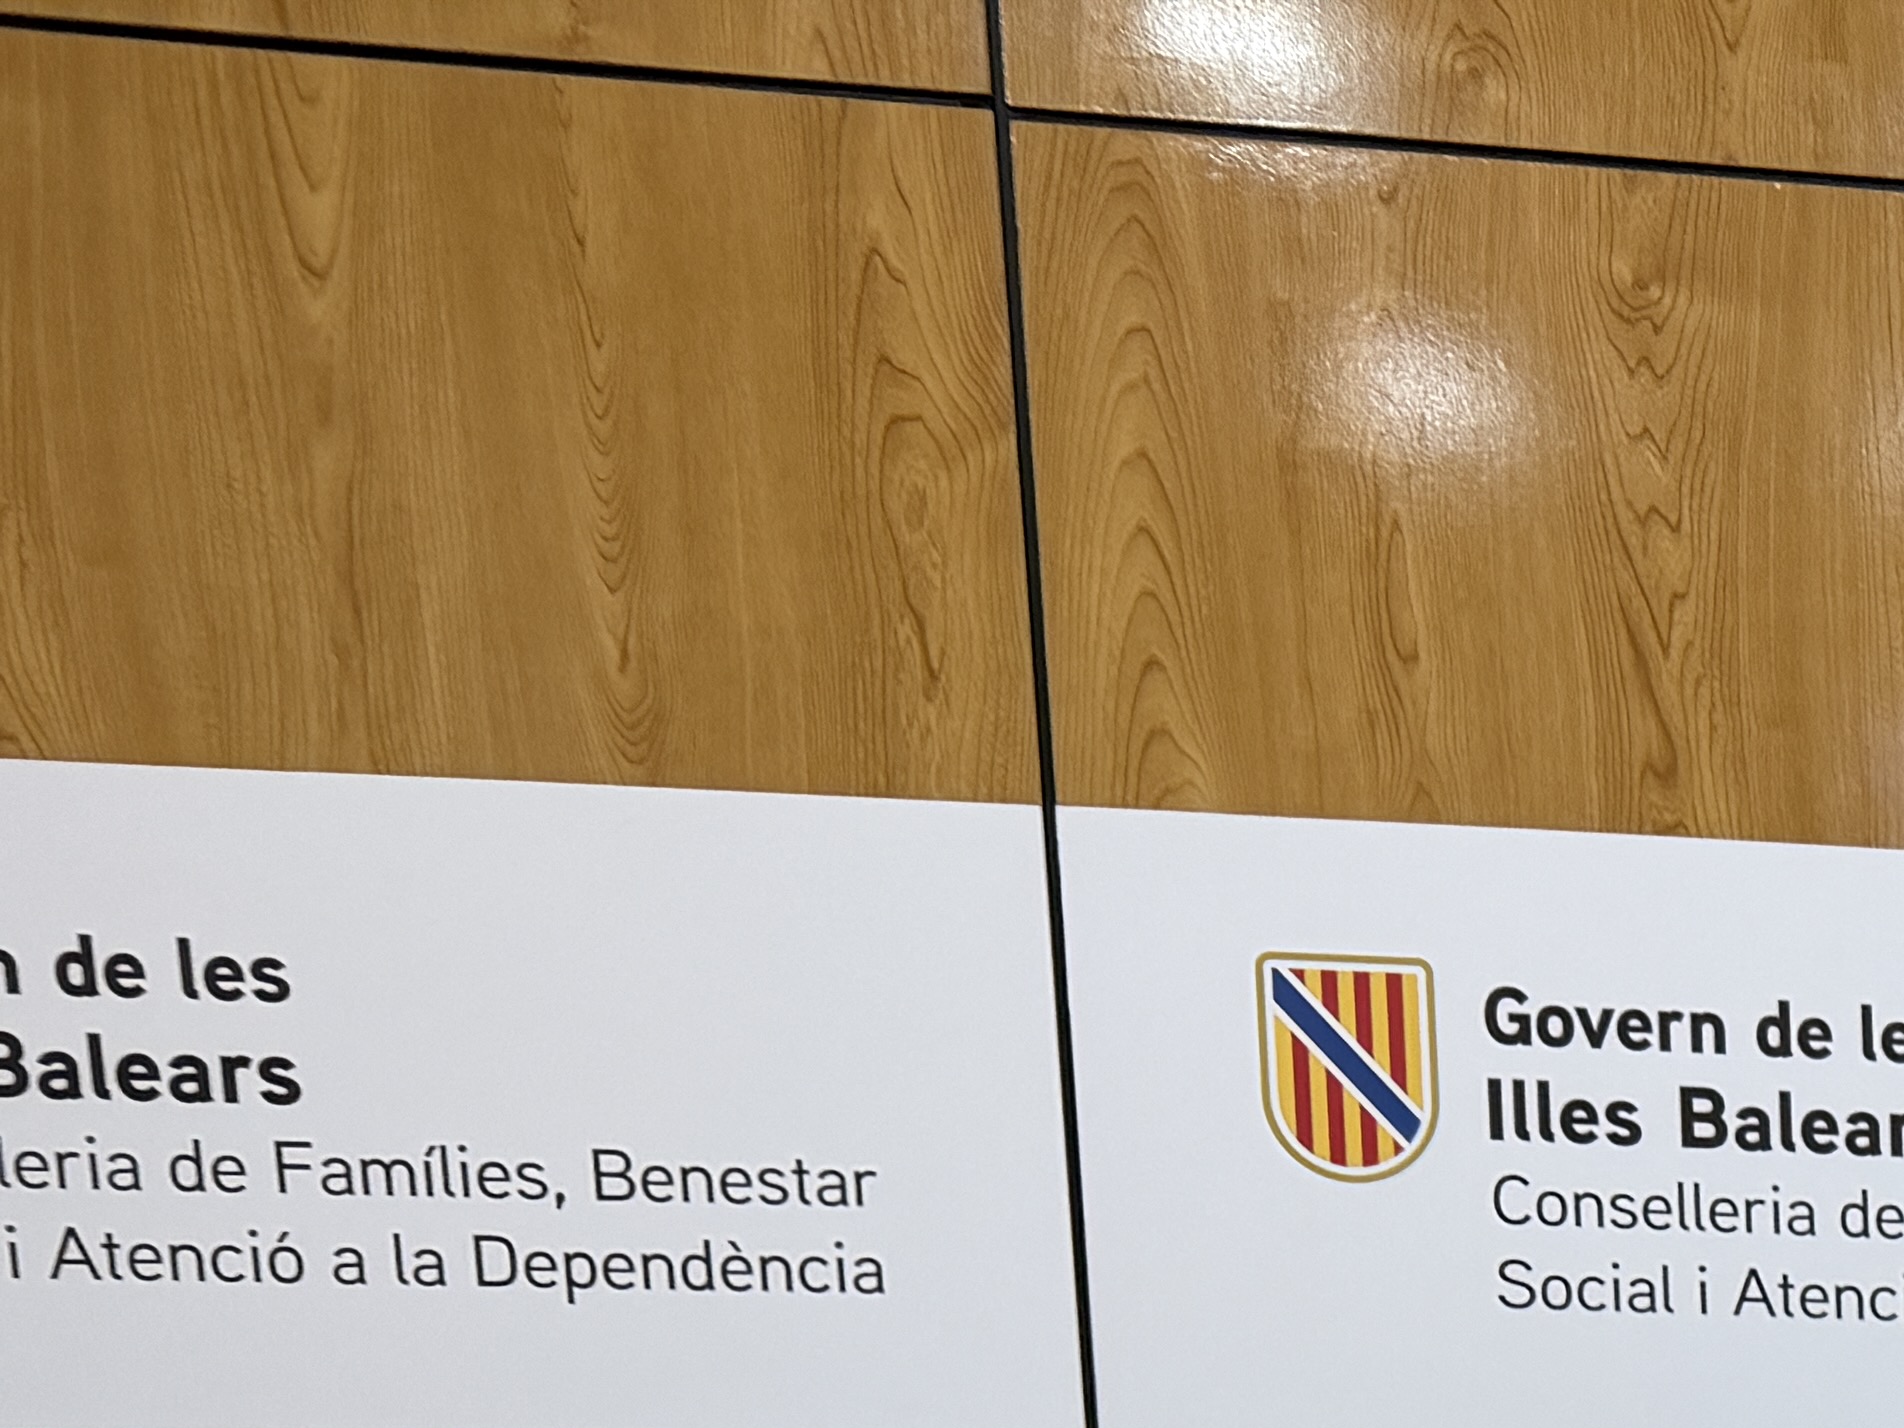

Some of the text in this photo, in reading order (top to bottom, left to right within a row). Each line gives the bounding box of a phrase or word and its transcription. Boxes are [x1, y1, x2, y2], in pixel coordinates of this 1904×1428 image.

[54, 934, 147, 999] de
[176, 937, 290, 1003] les
[1484, 986, 1726, 1055] Govern
[1756, 1000, 1833, 1060] de
[0, 1031, 302, 1106] Balears
[1487, 1078, 1642, 1147] Illes
[170, 1139, 246, 1193] de
[274, 1141, 565, 1210] Famílies,
[592, 1149, 877, 1207] Benestar
[1494, 1175, 1816, 1236] Conselleria
[1841, 1189, 1904, 1240] de
[5, 1225, 885, 1304] i Atenció a la Dependència
[1498, 1259, 1674, 1314] Social
[1698, 1265, 1707, 1315] i
